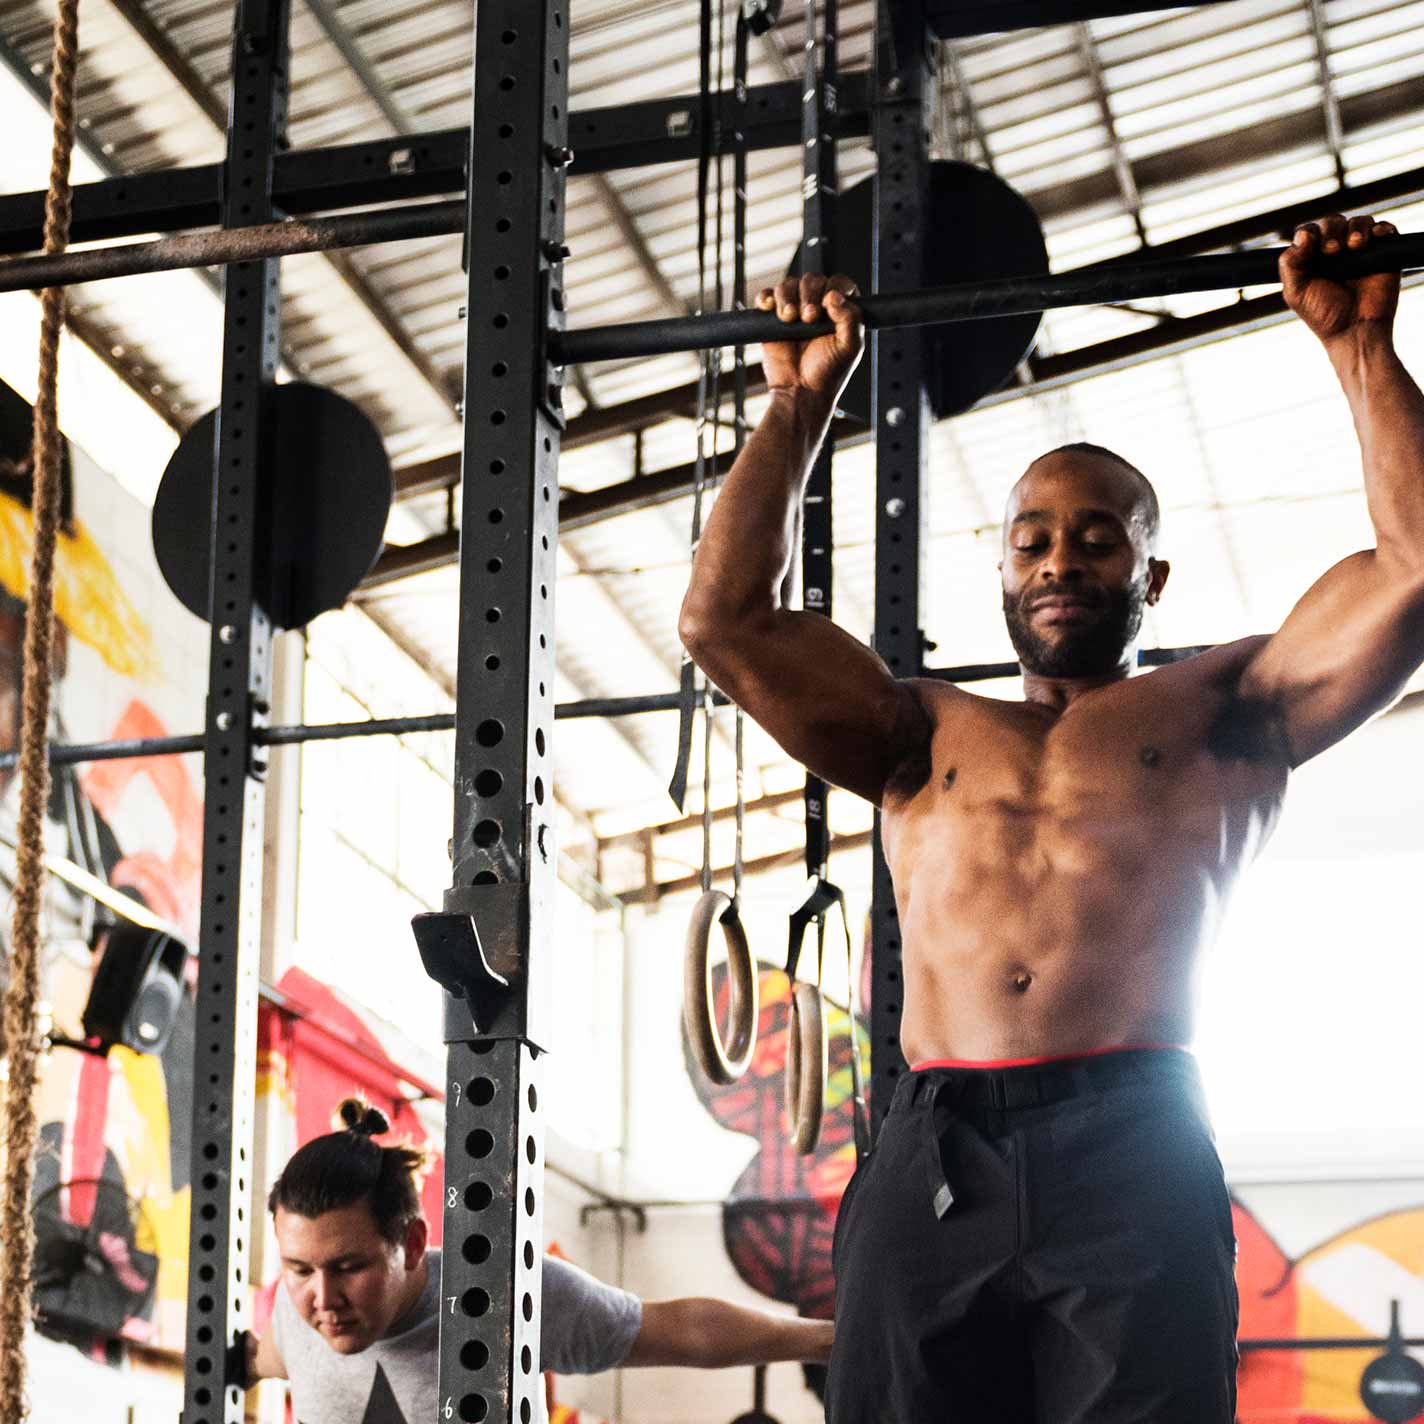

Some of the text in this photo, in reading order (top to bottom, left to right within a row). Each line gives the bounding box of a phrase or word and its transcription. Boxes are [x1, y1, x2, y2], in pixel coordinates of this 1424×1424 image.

[452, 1082, 462, 1107] 9
[447, 1186, 458, 1208] 8
[447, 1296, 456, 1314] 7
[444, 1397, 453, 1419] 6
